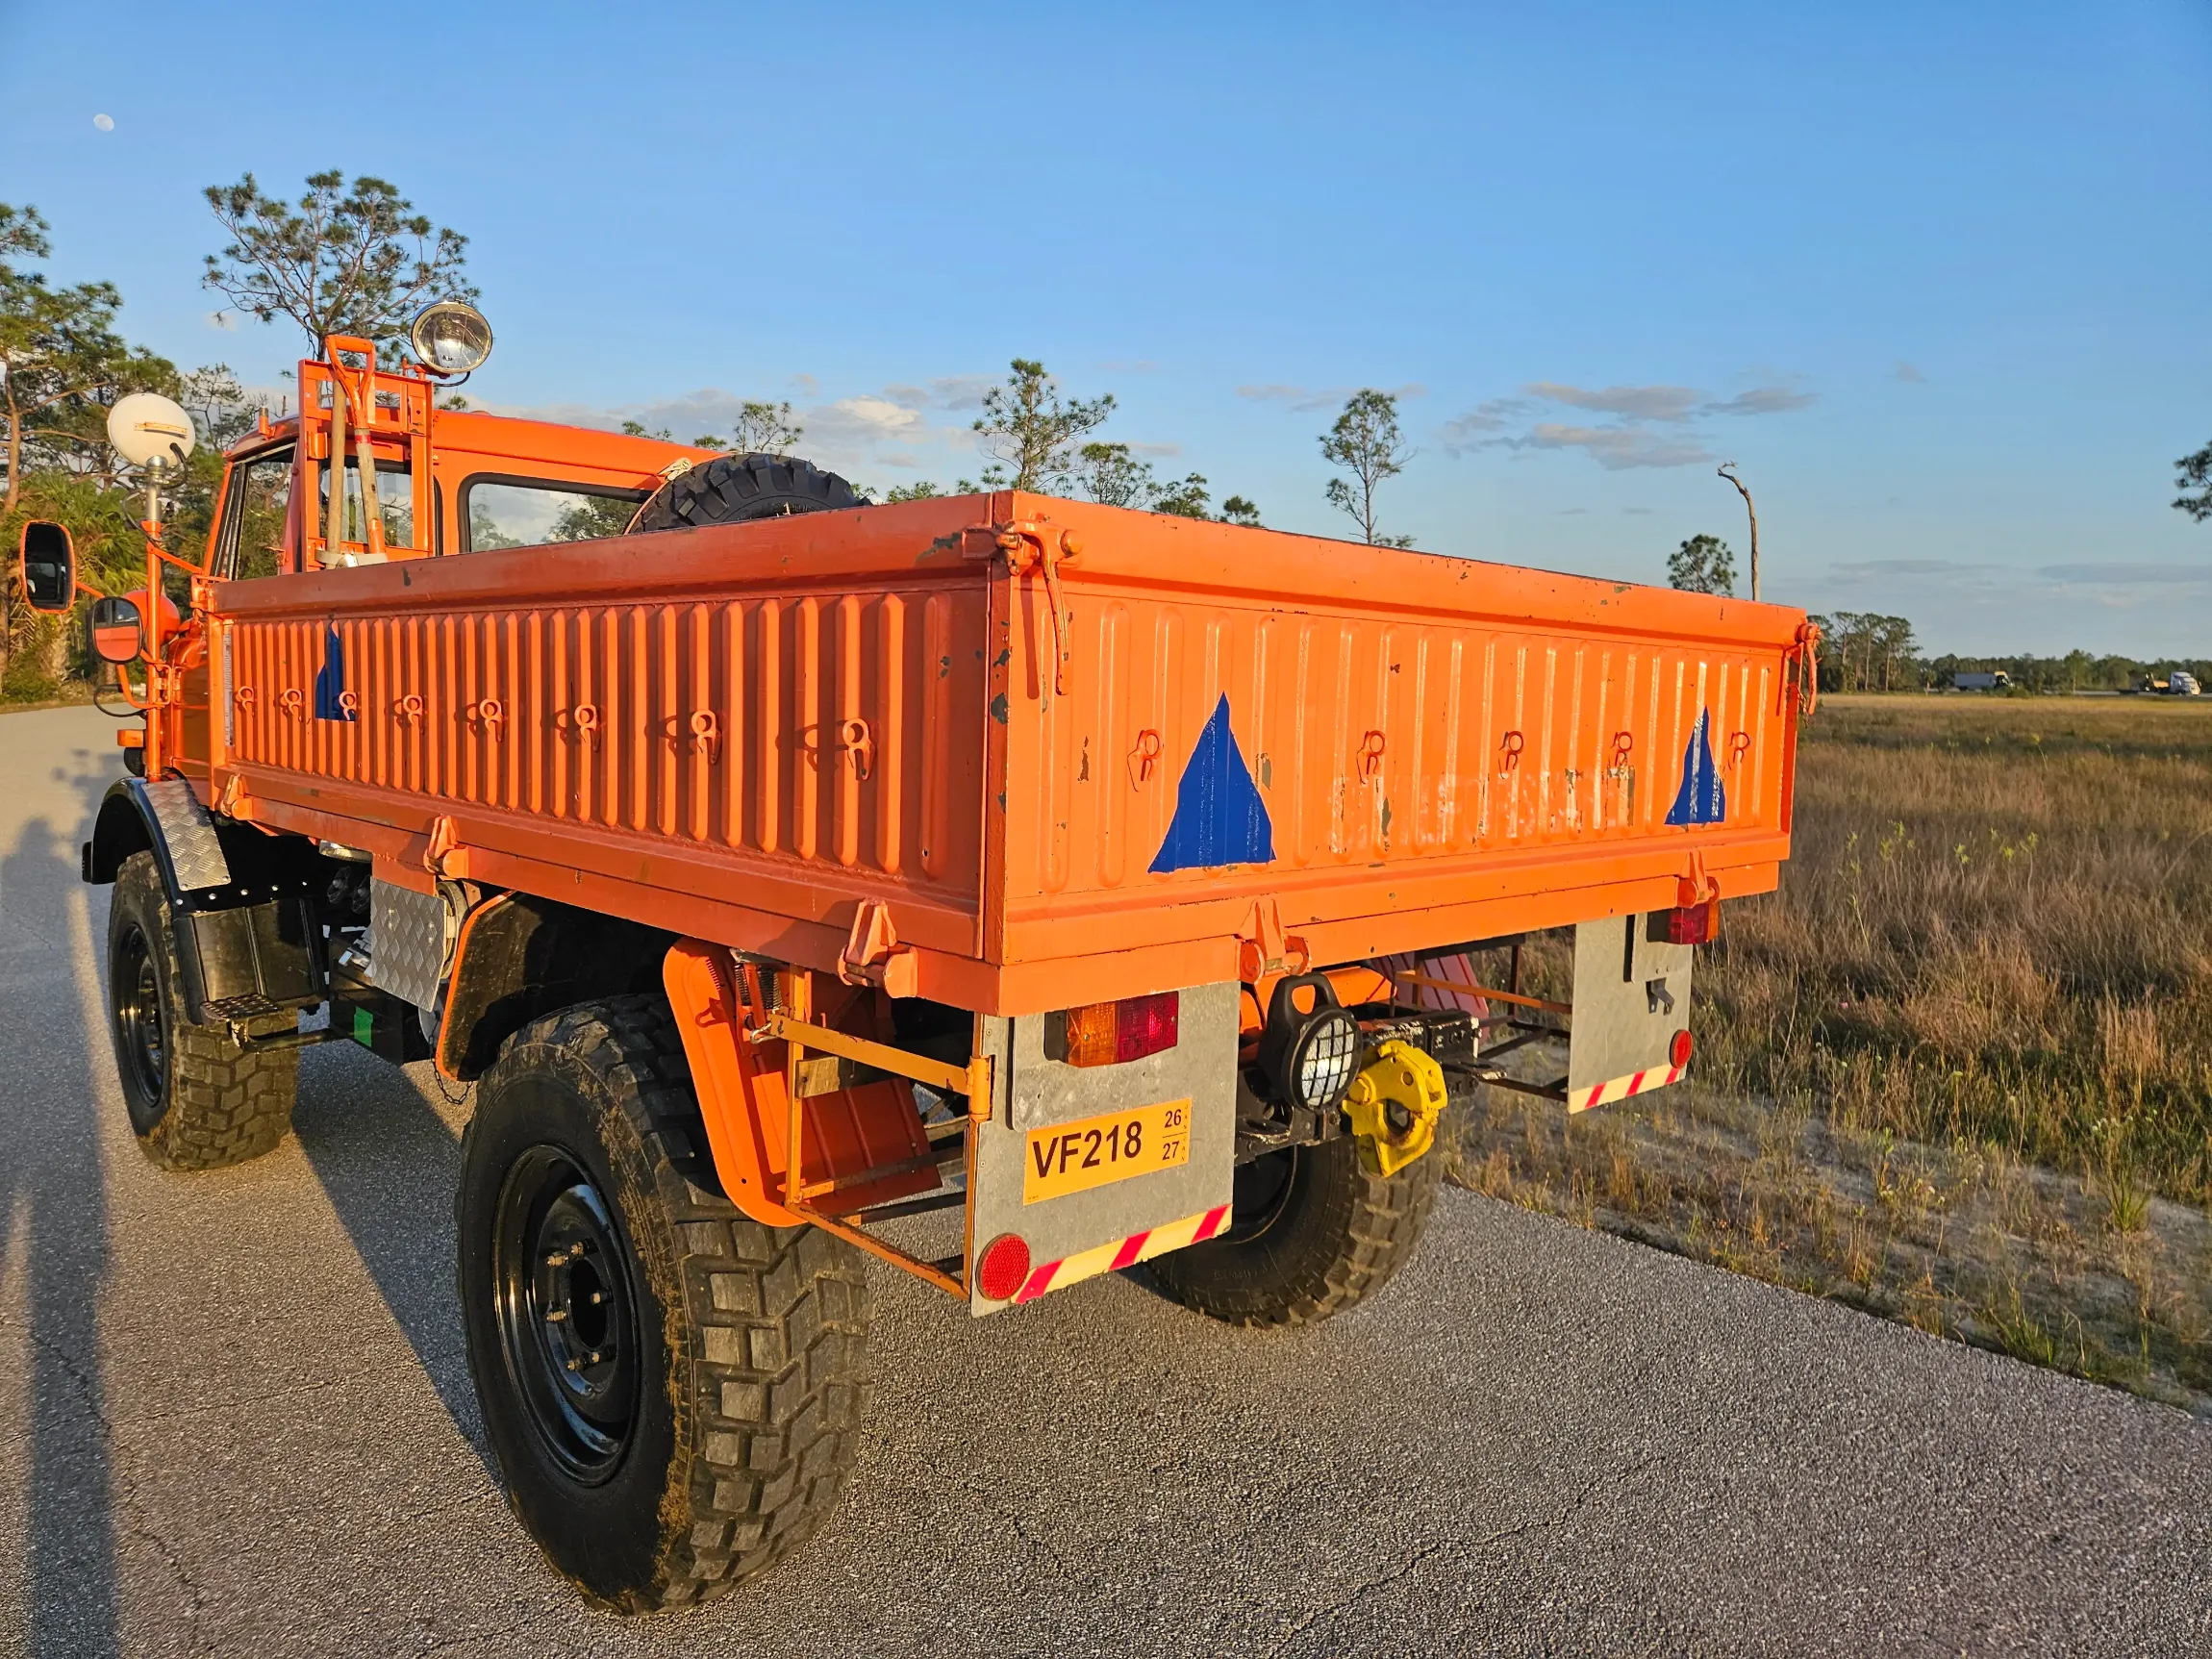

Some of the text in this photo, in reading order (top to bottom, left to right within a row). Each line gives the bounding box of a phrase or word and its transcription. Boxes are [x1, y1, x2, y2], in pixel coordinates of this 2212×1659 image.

[1164, 1108, 1182, 1128] 26
[1032, 1120, 1143, 1179] VF218
[1162, 1140, 1180, 1161] 27
